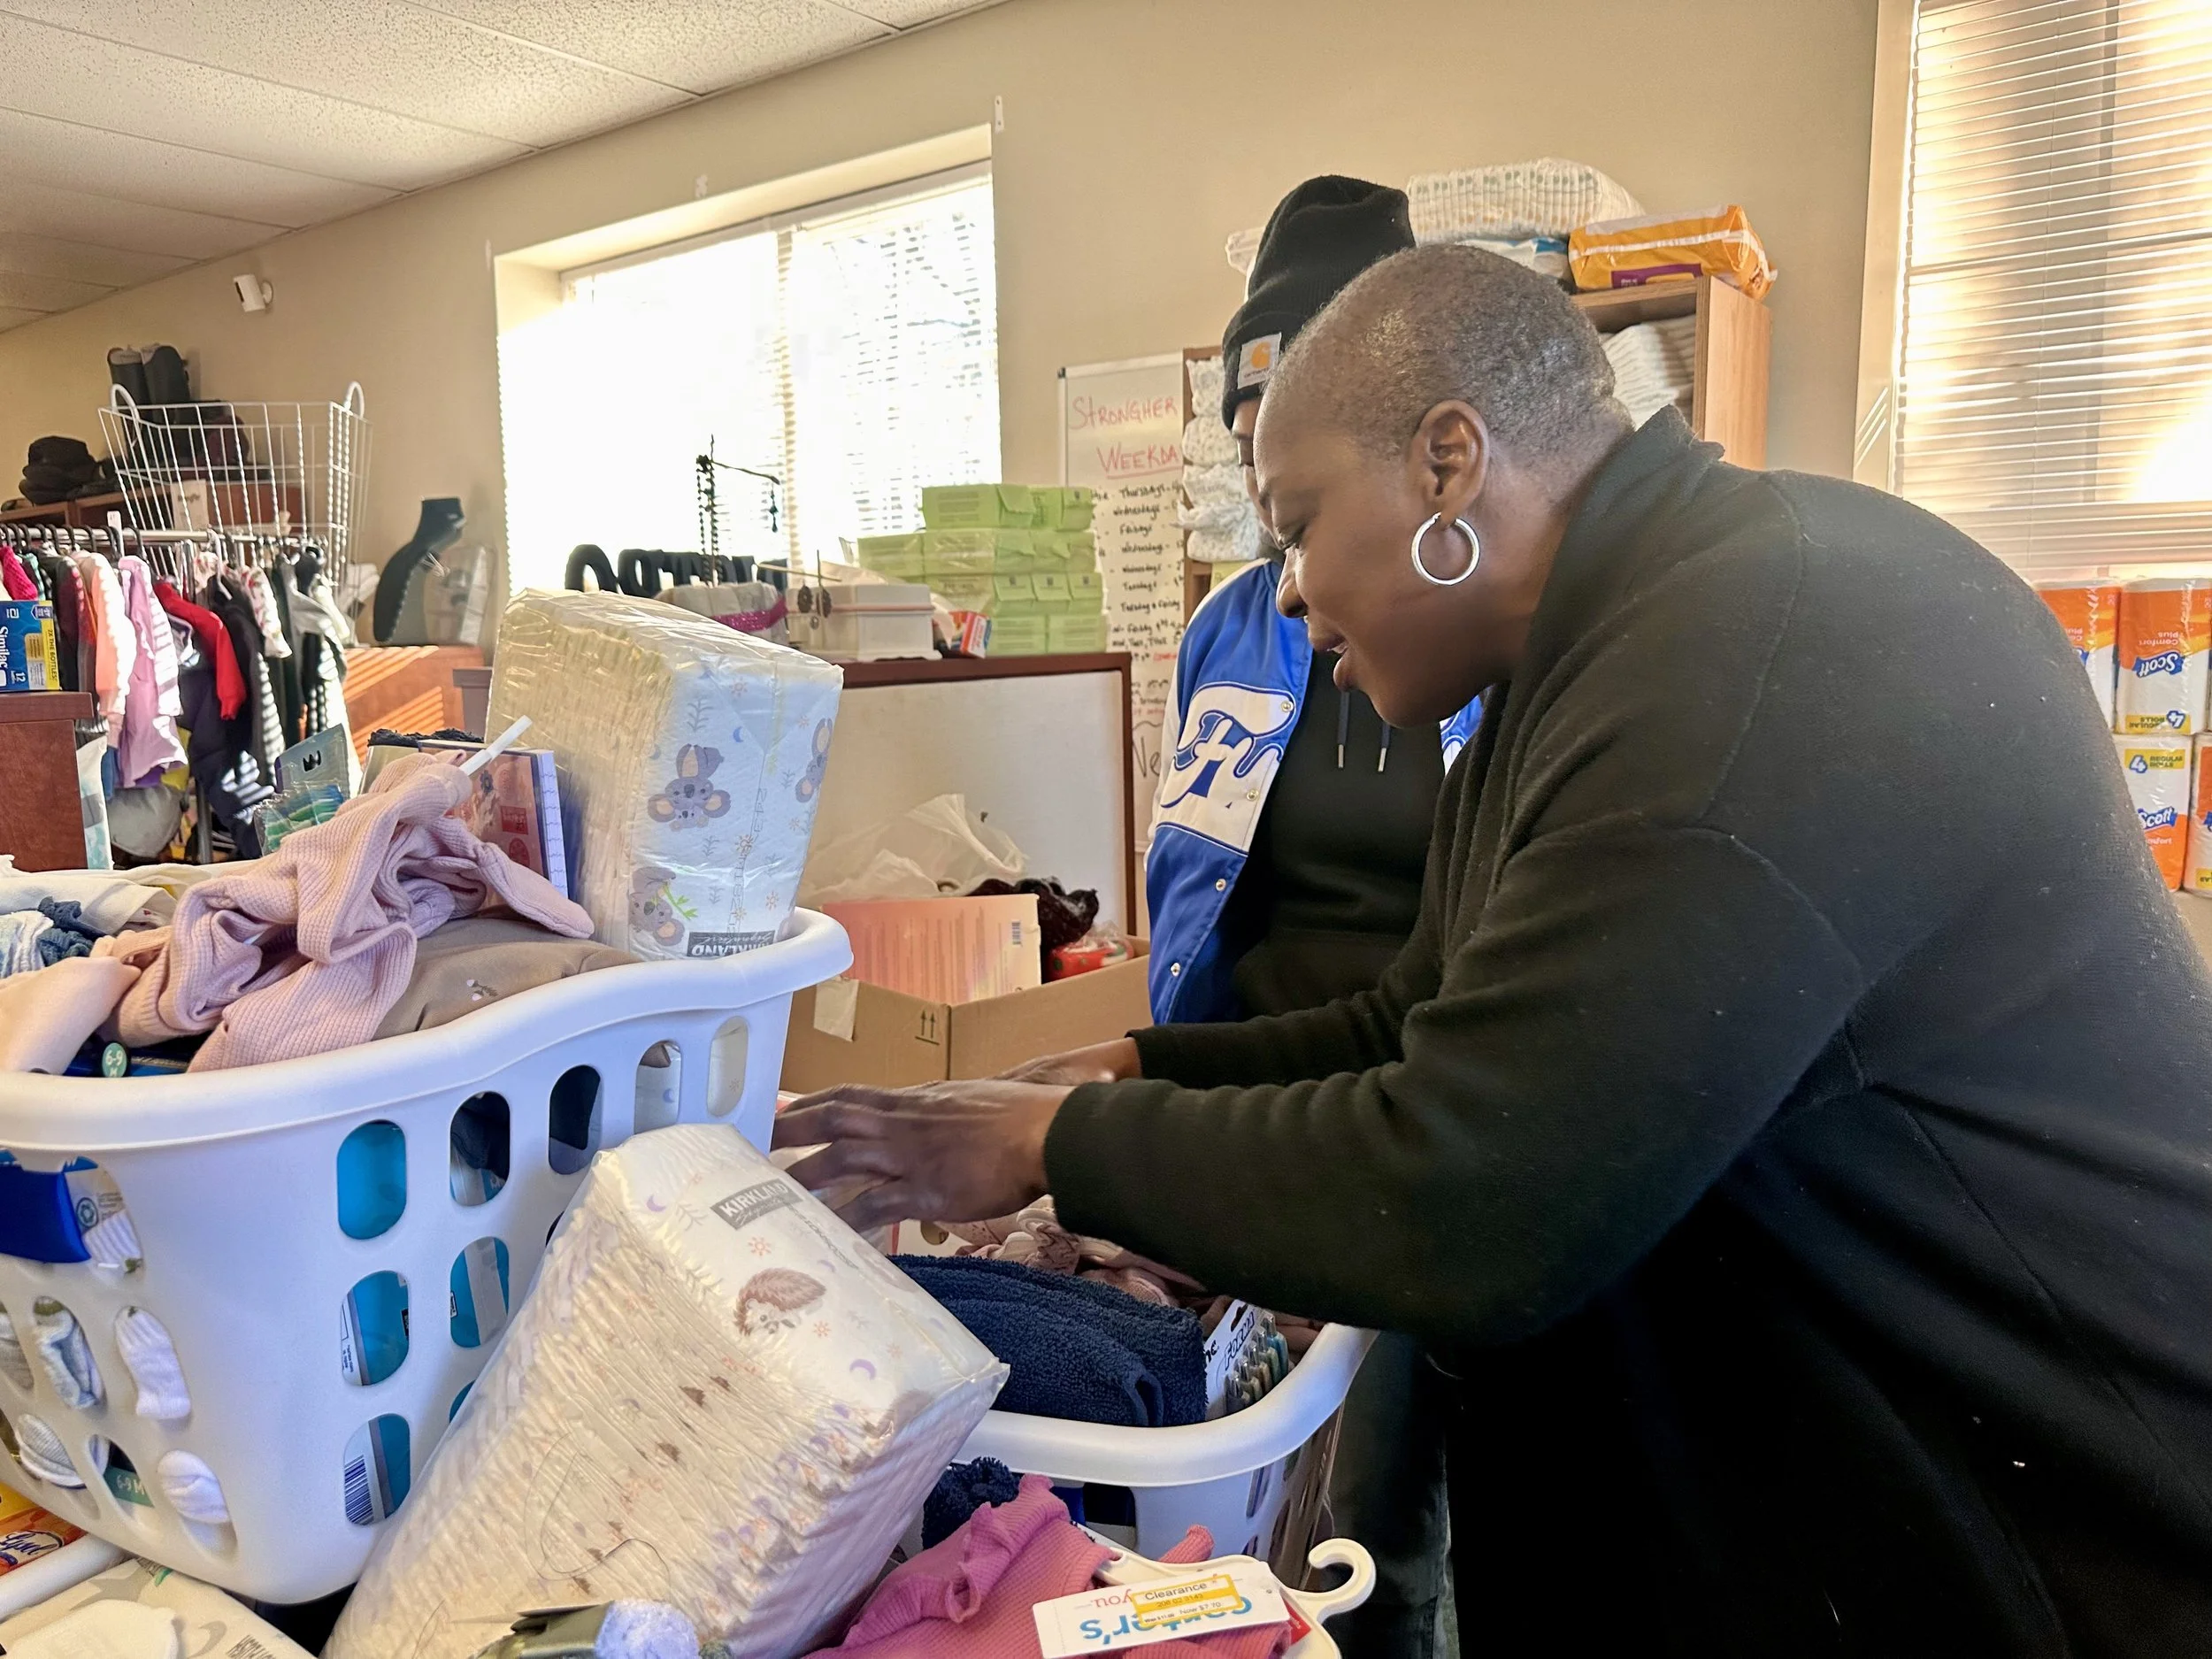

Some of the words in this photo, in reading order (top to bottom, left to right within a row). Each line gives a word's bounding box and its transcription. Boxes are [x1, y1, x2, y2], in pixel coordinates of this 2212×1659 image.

[2138, 653, 2178, 677] Scott
[15, 672, 26, 682] 12
[2130, 755, 2147, 772] 4
[2138, 809, 2173, 829] Scott
[105, 1049, 124, 1066] 6-9
[1145, 1582, 1208, 1601] Clearance
[1179, 1606, 1198, 1615] Now
